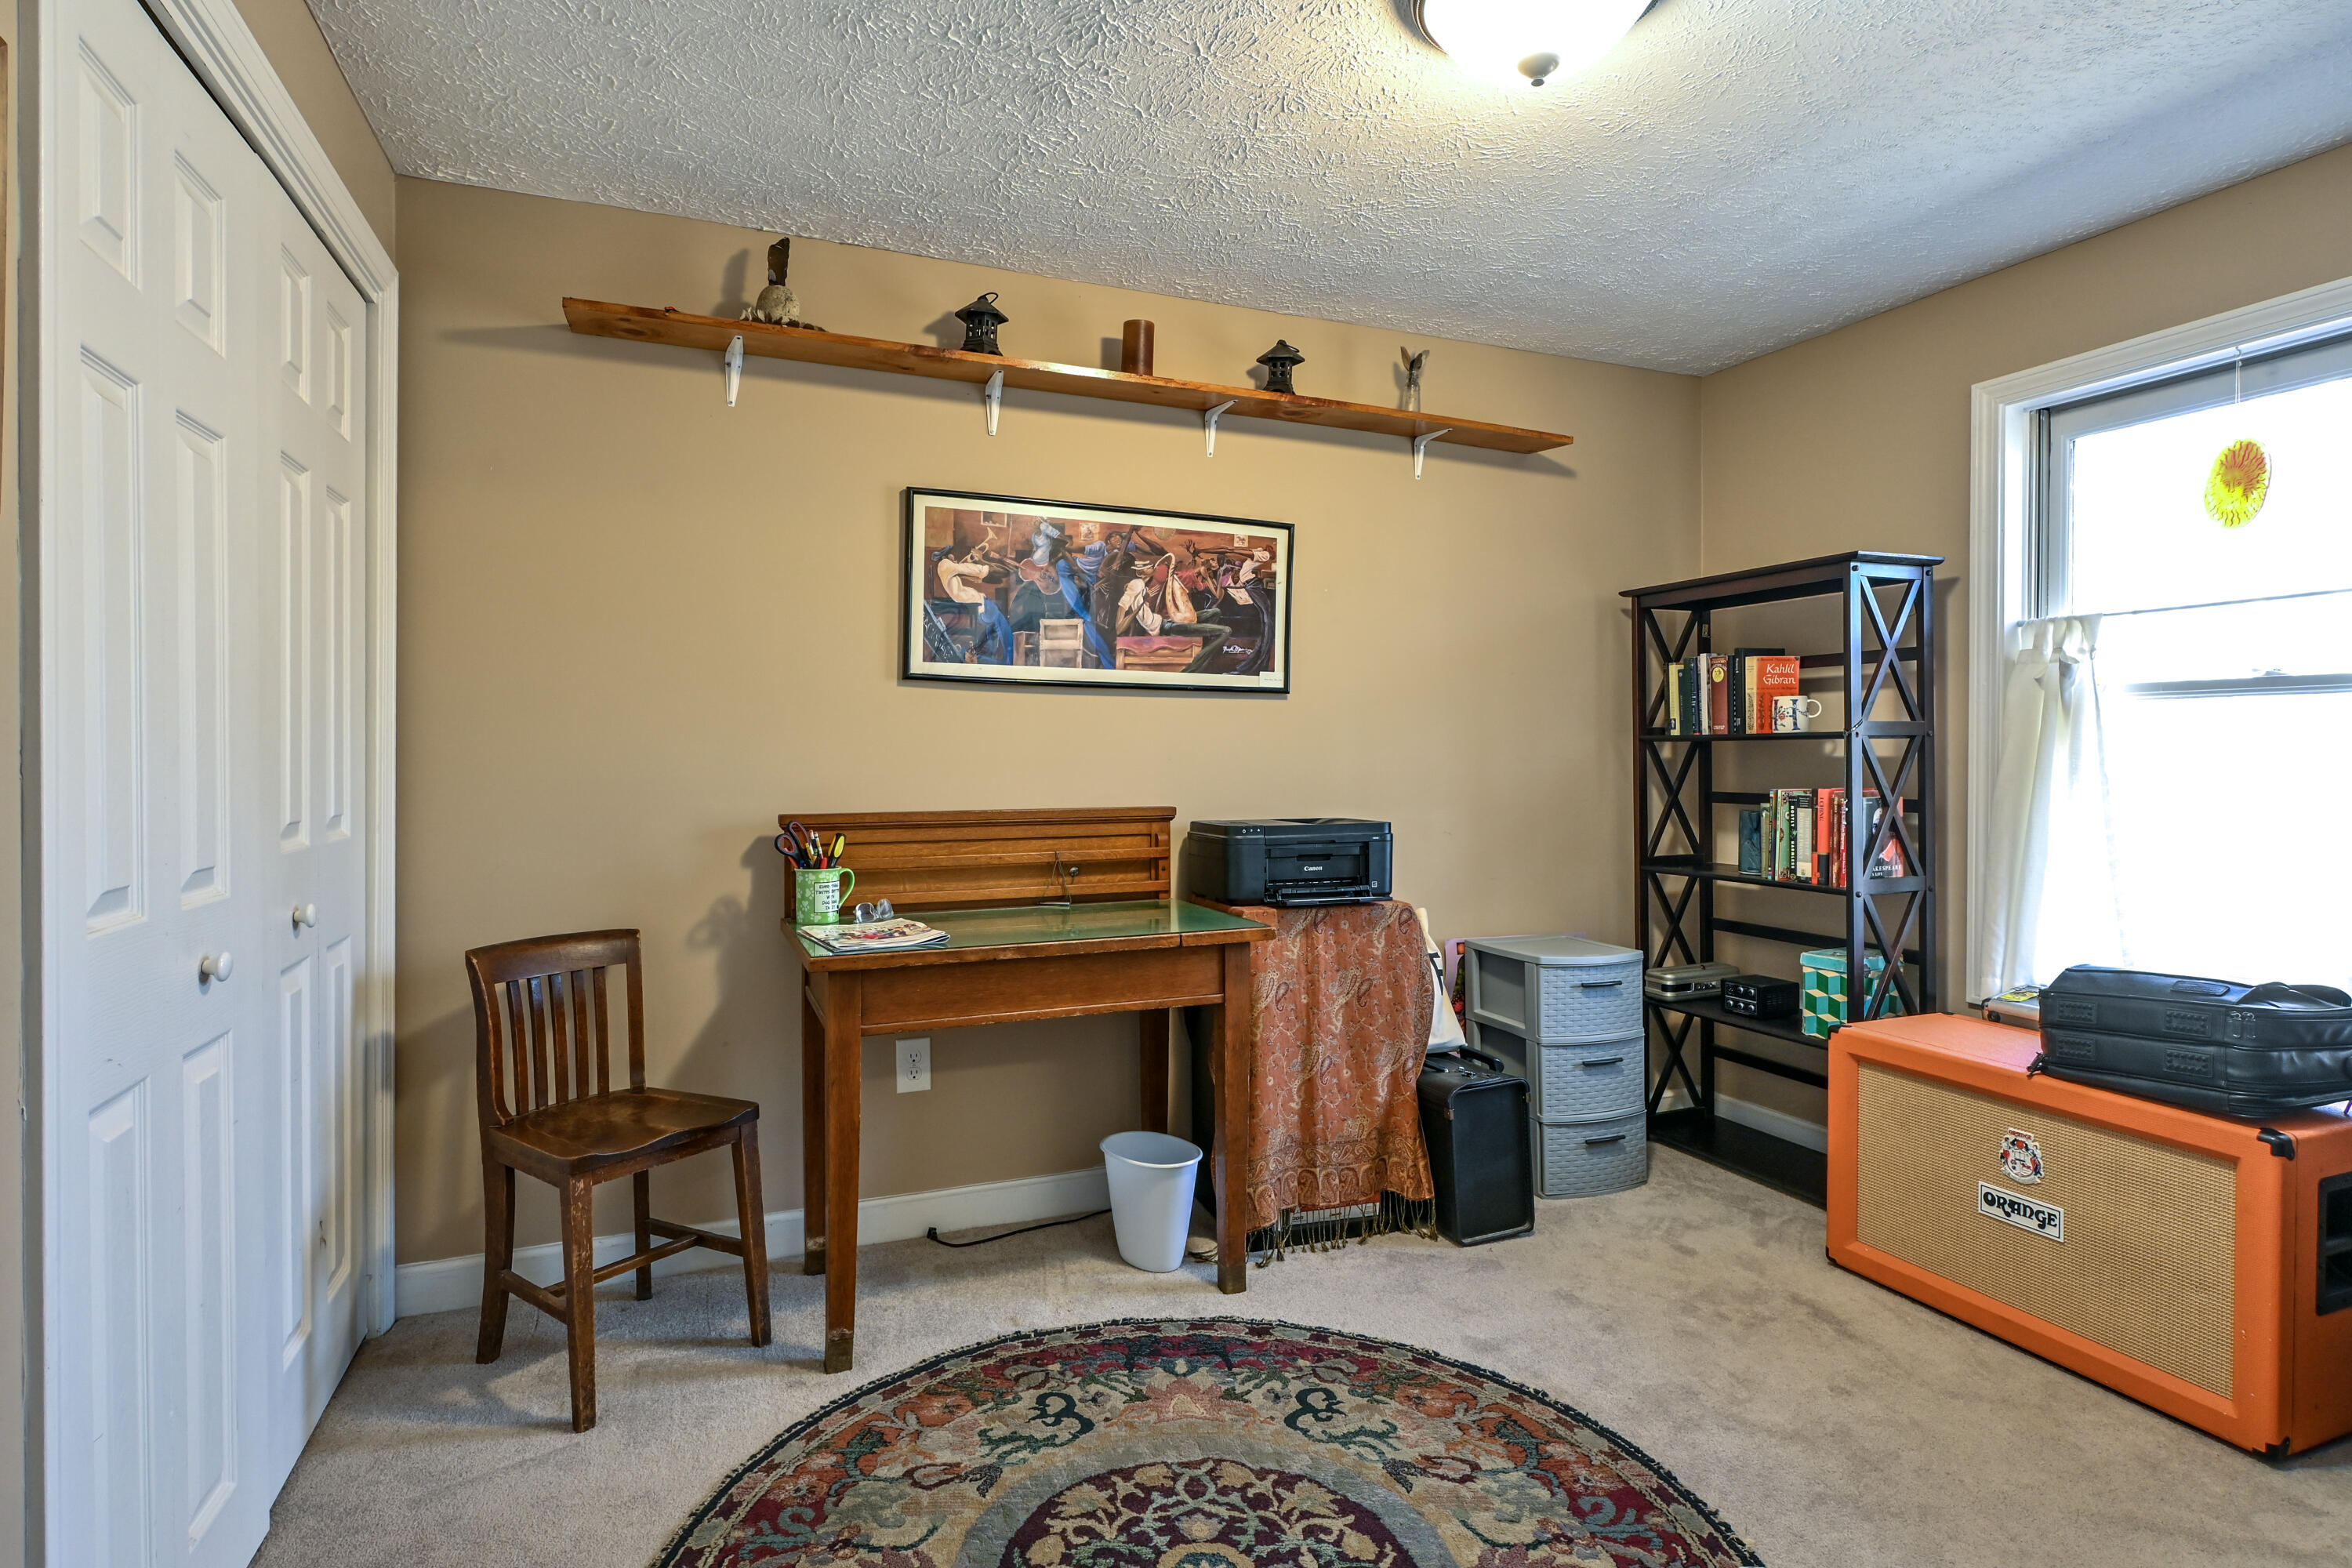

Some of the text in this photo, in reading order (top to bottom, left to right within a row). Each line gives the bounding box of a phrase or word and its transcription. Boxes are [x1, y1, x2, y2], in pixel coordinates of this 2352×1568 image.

[1766, 663, 1795, 673] Kahlil
[1763, 674, 1796, 685] Gibran
[1983, 1191, 2057, 1230] ORANGE
